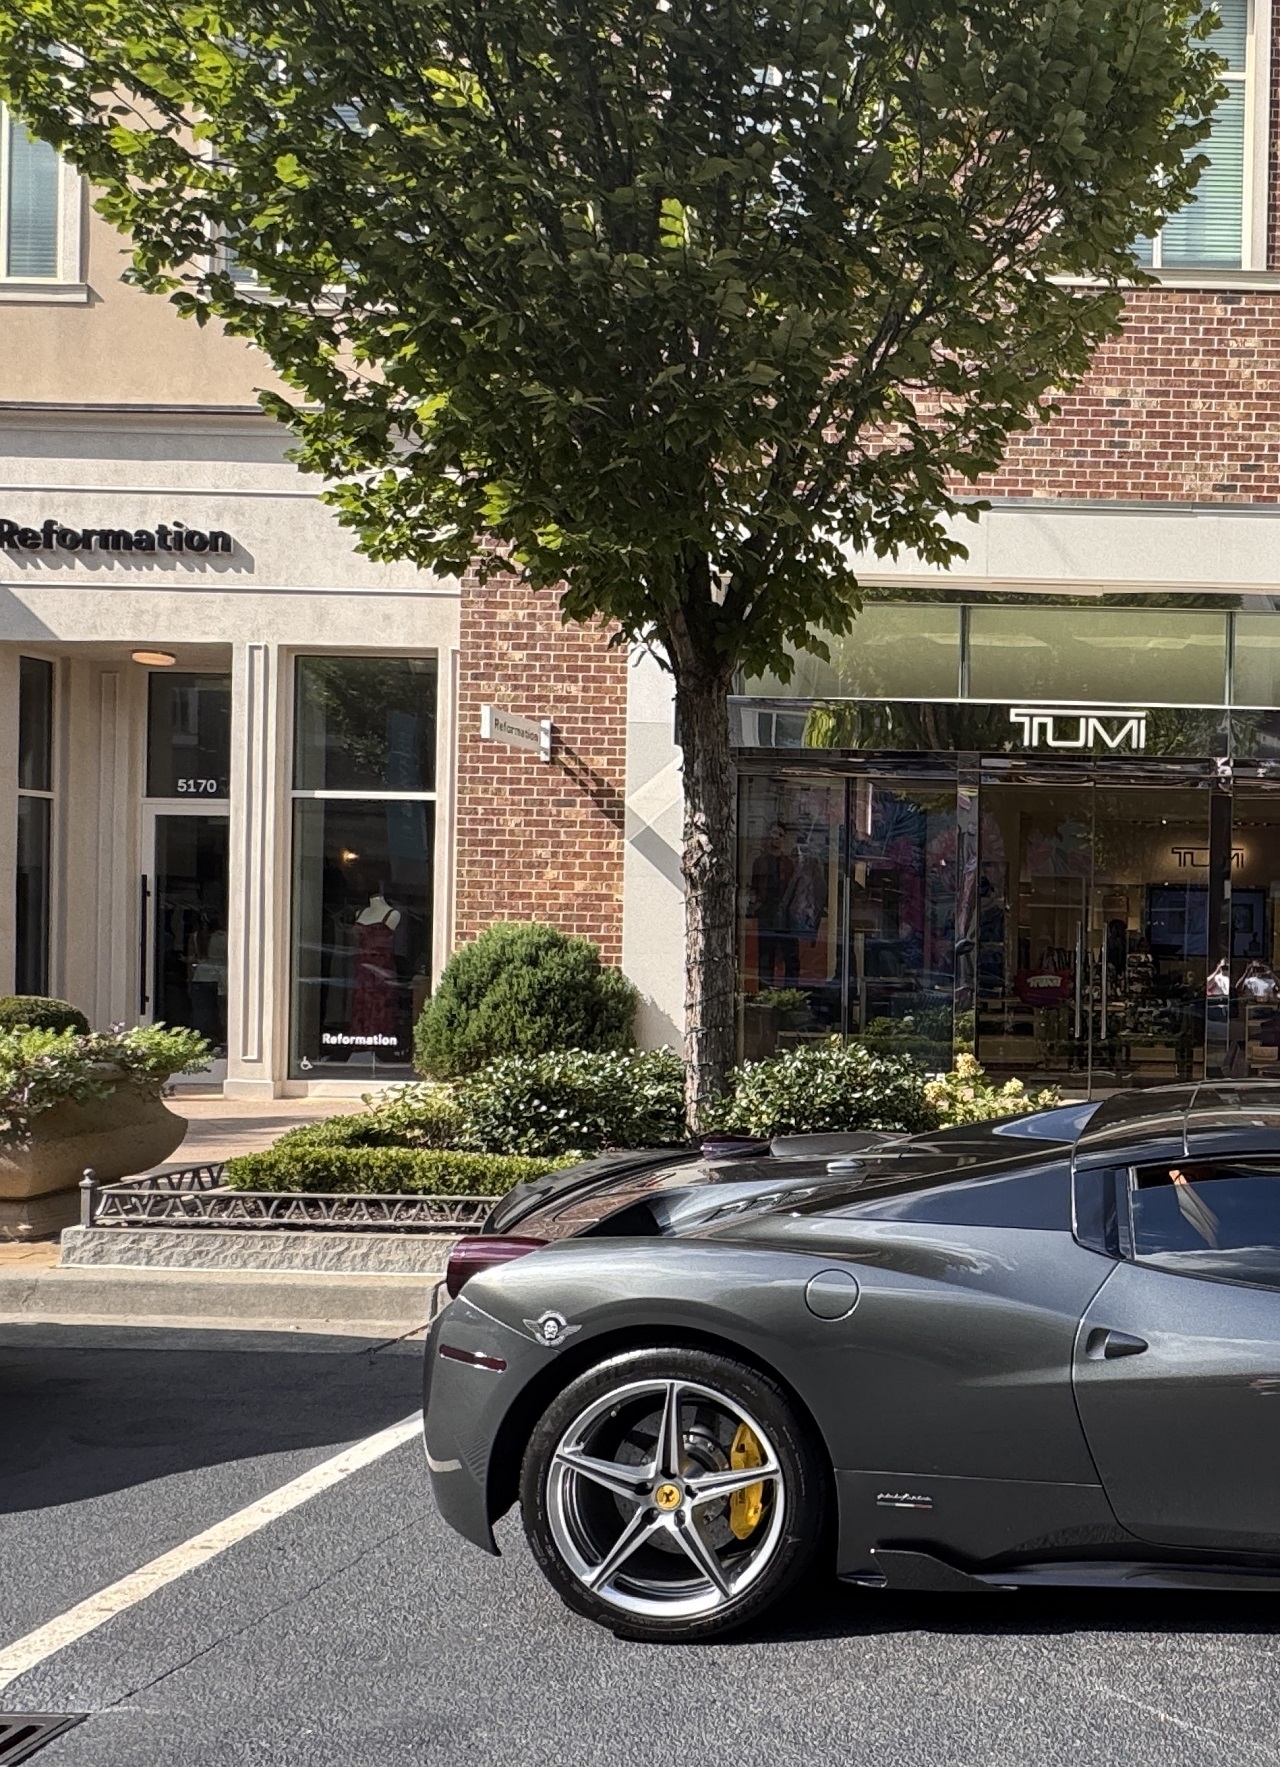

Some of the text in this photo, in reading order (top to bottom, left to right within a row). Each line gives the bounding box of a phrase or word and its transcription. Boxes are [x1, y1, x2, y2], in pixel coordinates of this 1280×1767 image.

[0, 518, 232, 553] Reformation
[1010, 708, 1146, 749] TUMI
[177, 778, 217, 793] 5170
[322, 1032, 398, 1046] Reformation
